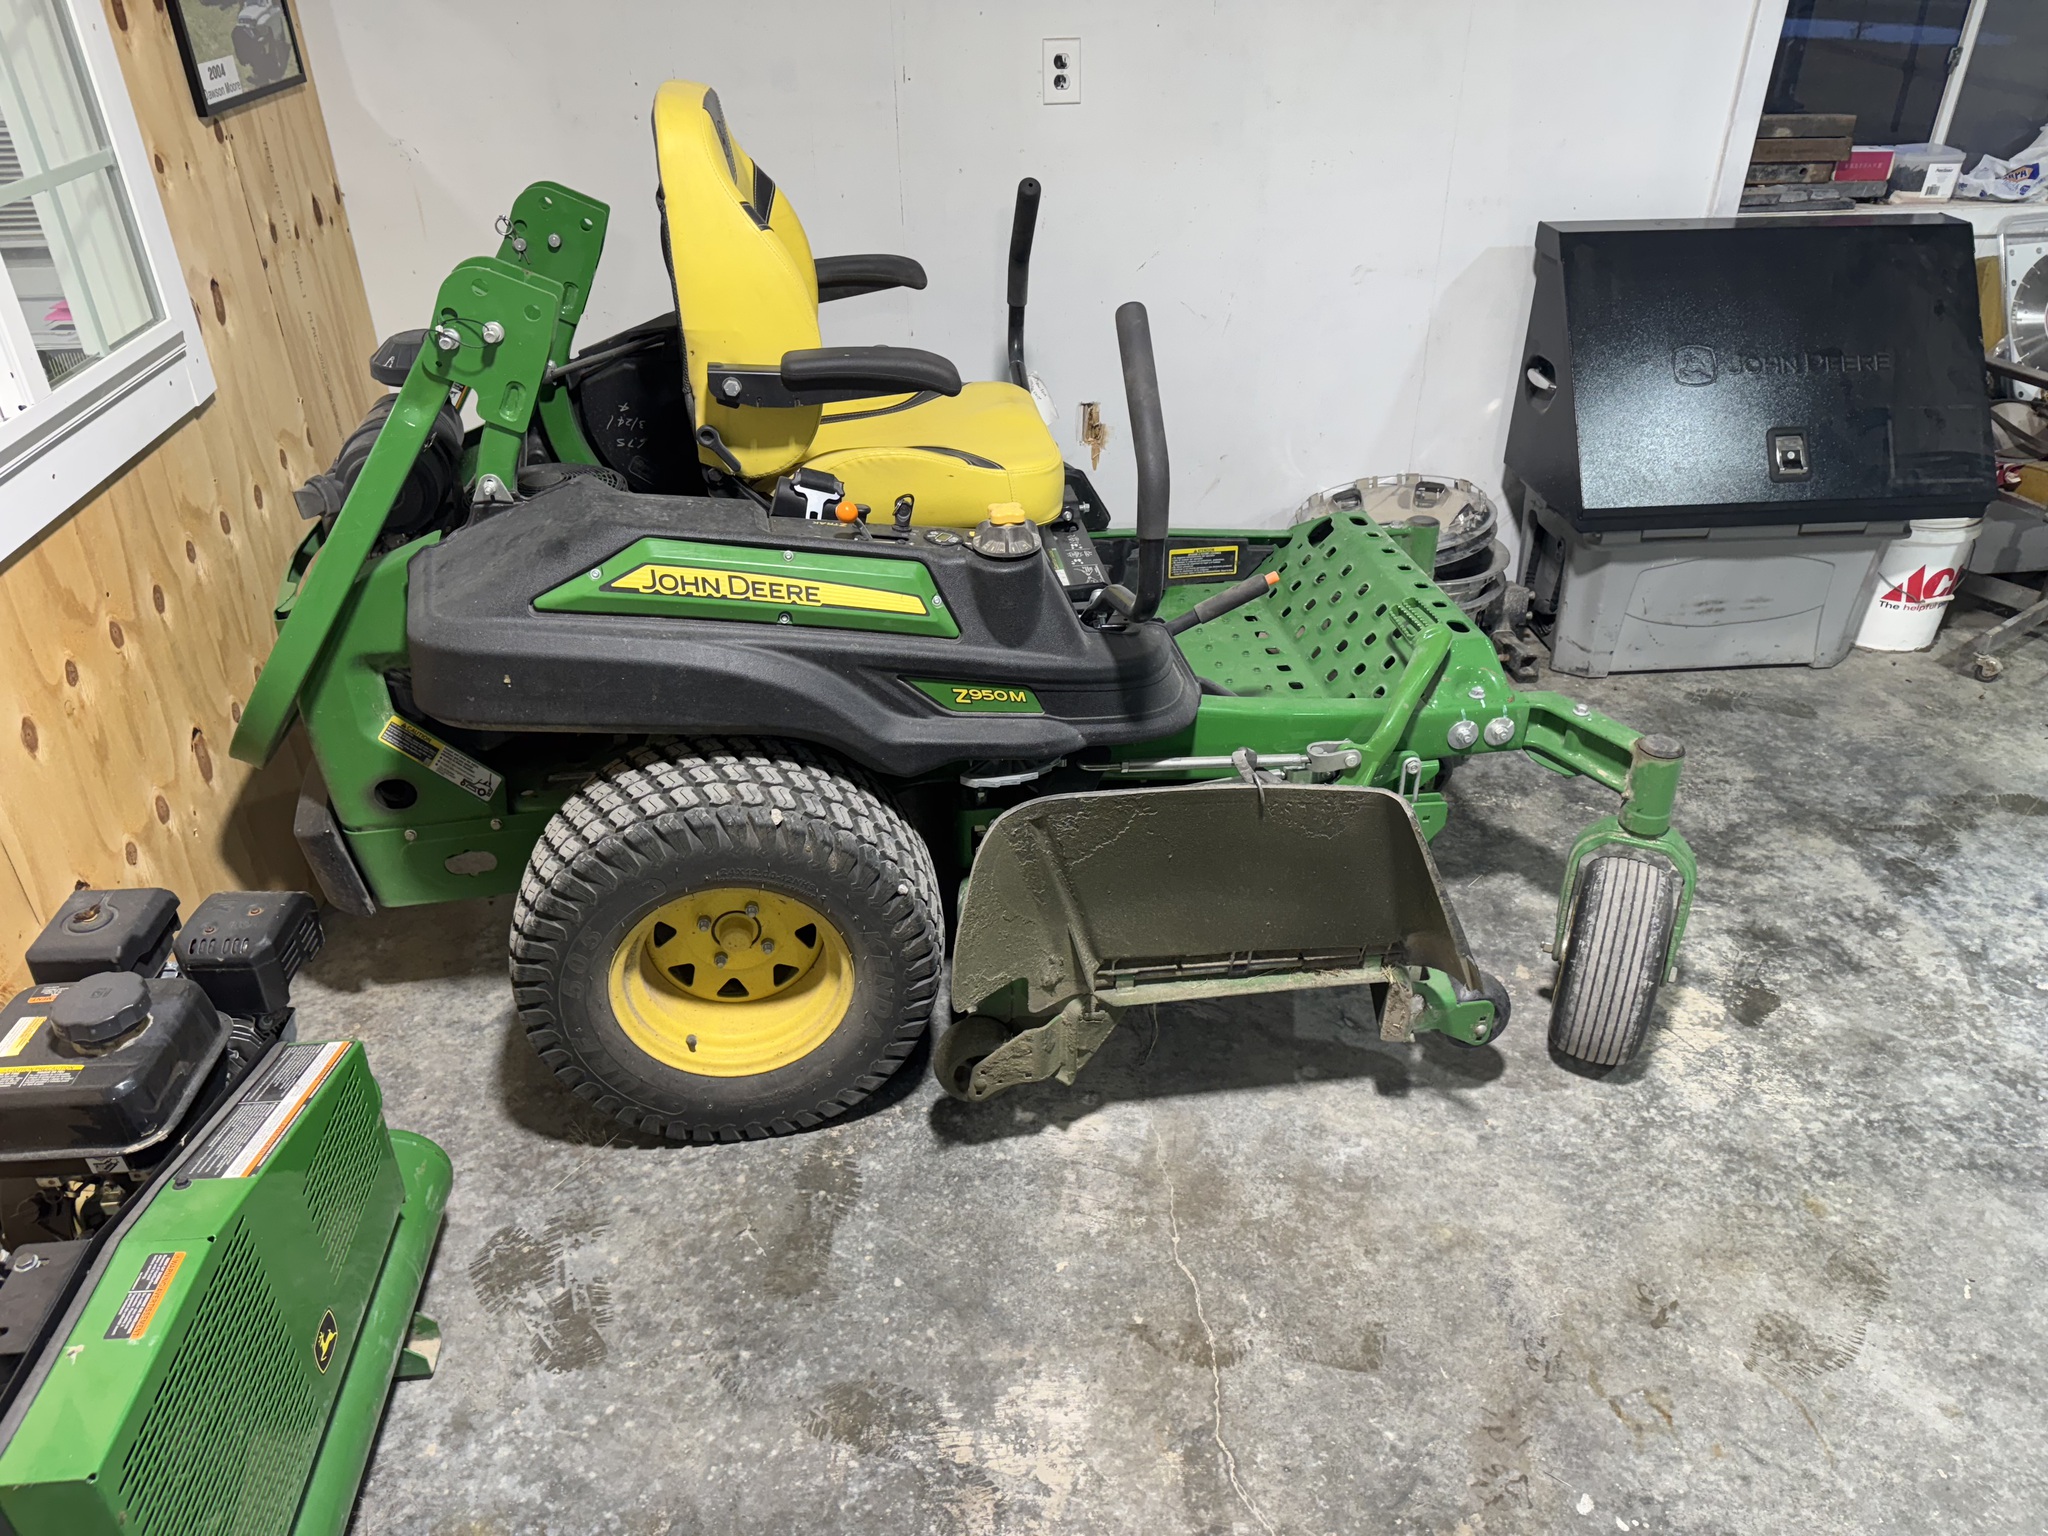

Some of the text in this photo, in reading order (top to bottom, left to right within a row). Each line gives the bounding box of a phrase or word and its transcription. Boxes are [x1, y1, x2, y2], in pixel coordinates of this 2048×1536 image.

[207, 63, 226, 80] 2004
[224, 81, 241, 94] Moore
[1726, 353, 1798, 376] JOHN
[641, 569, 822, 604] JOHN DEERE
[1879, 600, 1900, 611] The
[952, 688, 1027, 703] Z950M
[407, 725, 432, 743] CAUTION
